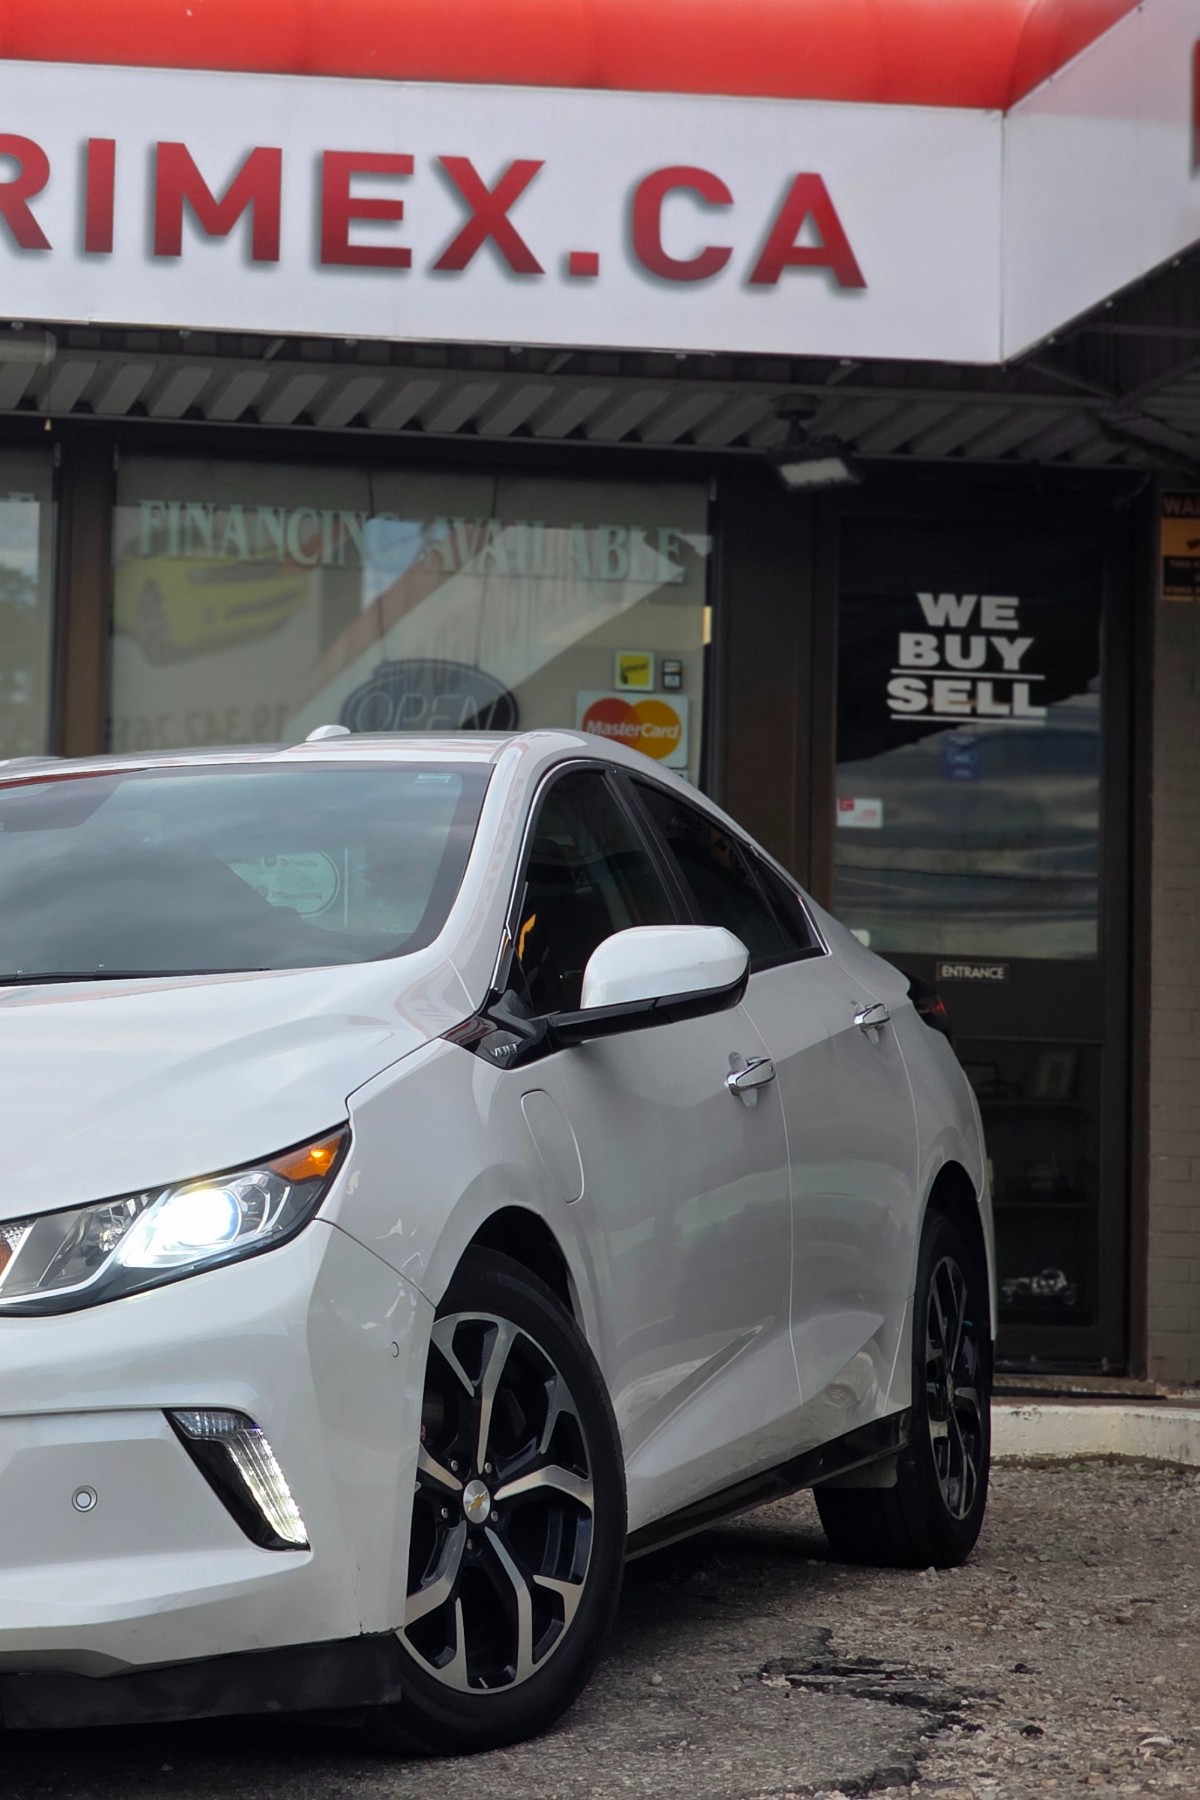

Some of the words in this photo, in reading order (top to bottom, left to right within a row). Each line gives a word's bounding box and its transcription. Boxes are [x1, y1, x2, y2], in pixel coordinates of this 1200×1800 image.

[138, 500, 402, 568] FINANCIN
[916, 592, 1020, 630] WE
[899, 632, 1034, 670] BUY
[886, 676, 1047, 718] SELL
[586, 720, 680, 739] MasterCard
[941, 964, 1005, 980] ENTRANCE
